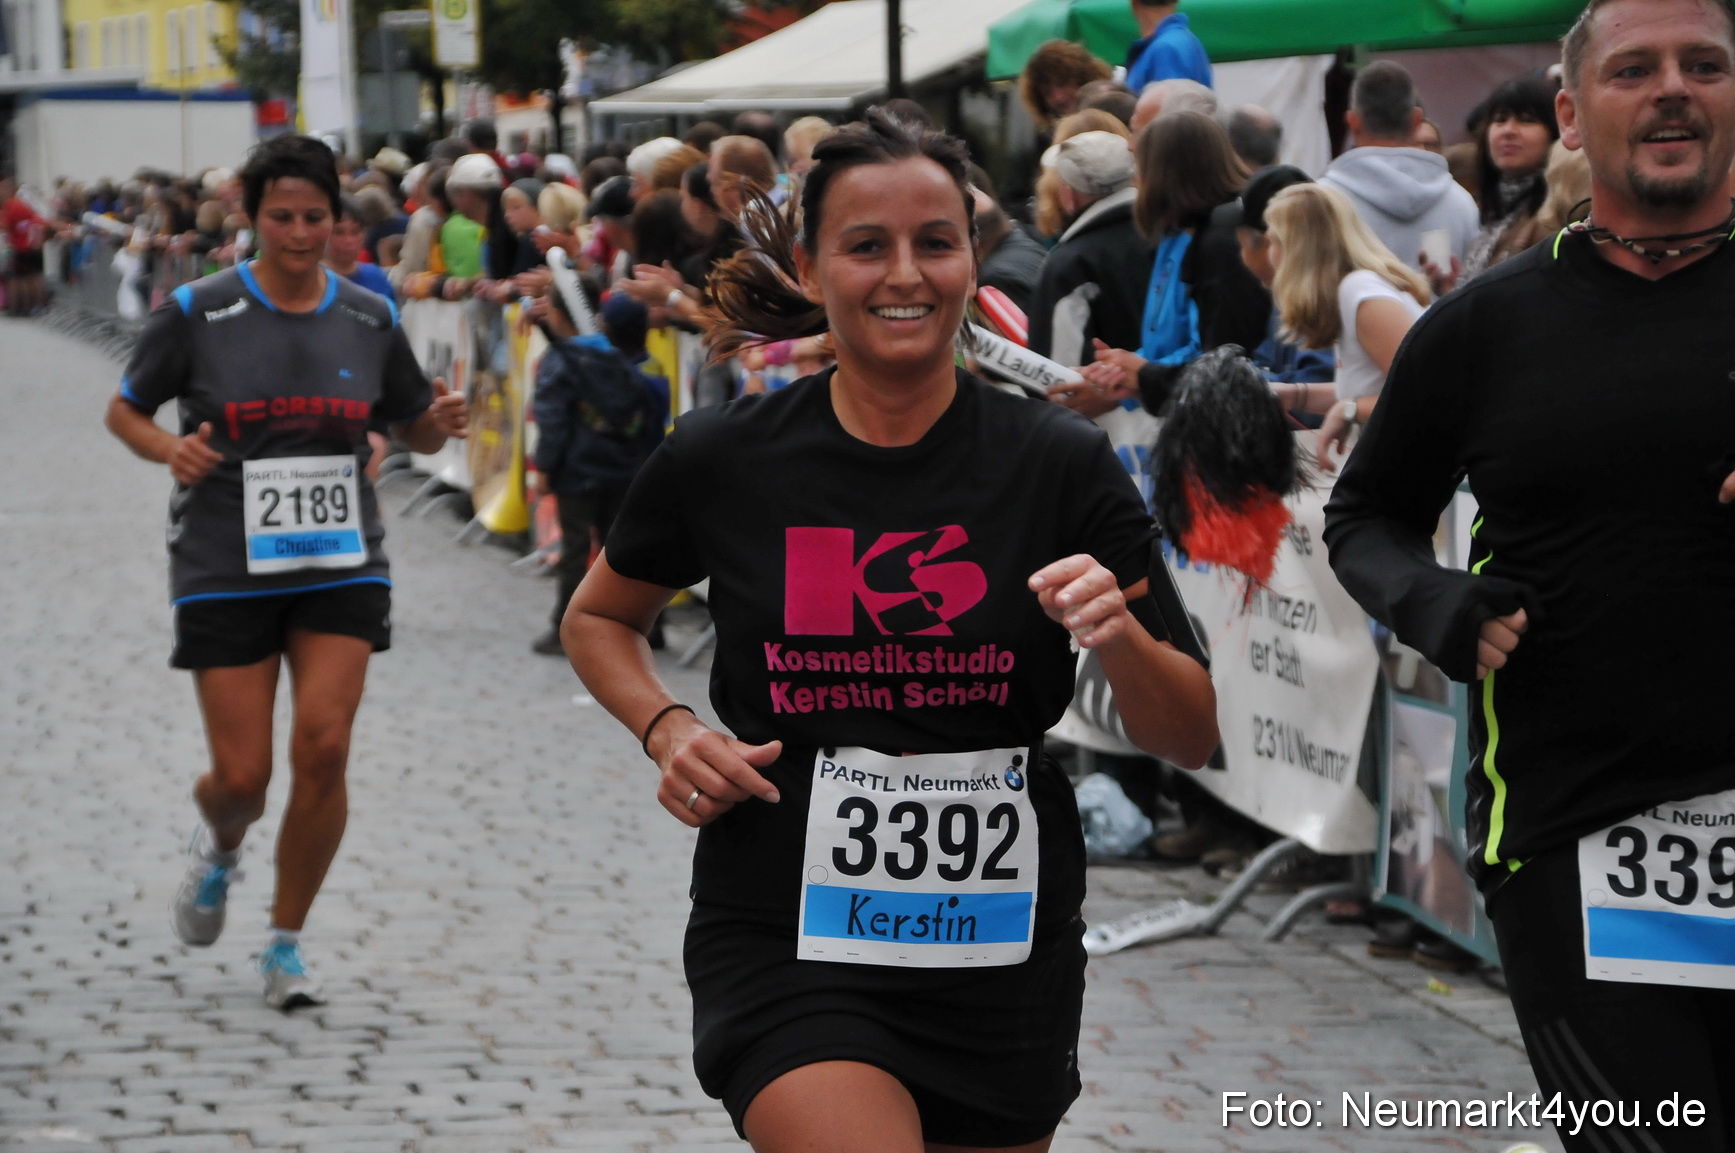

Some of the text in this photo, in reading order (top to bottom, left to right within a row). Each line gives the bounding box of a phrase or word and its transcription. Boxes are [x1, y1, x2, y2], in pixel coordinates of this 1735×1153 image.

[246, 469, 338, 481] PARTL Neumarkt
[258, 483, 348, 527] 2189
[275, 537, 341, 554] Christine
[764, 642, 1015, 674] Kosmetikstudio
[770, 682, 1008, 713] Kerstin Schöll
[820, 760, 1001, 792] PARTL Neumarkt
[832, 796, 1020, 882] 3392
[847, 893, 976, 942] Kerstin
